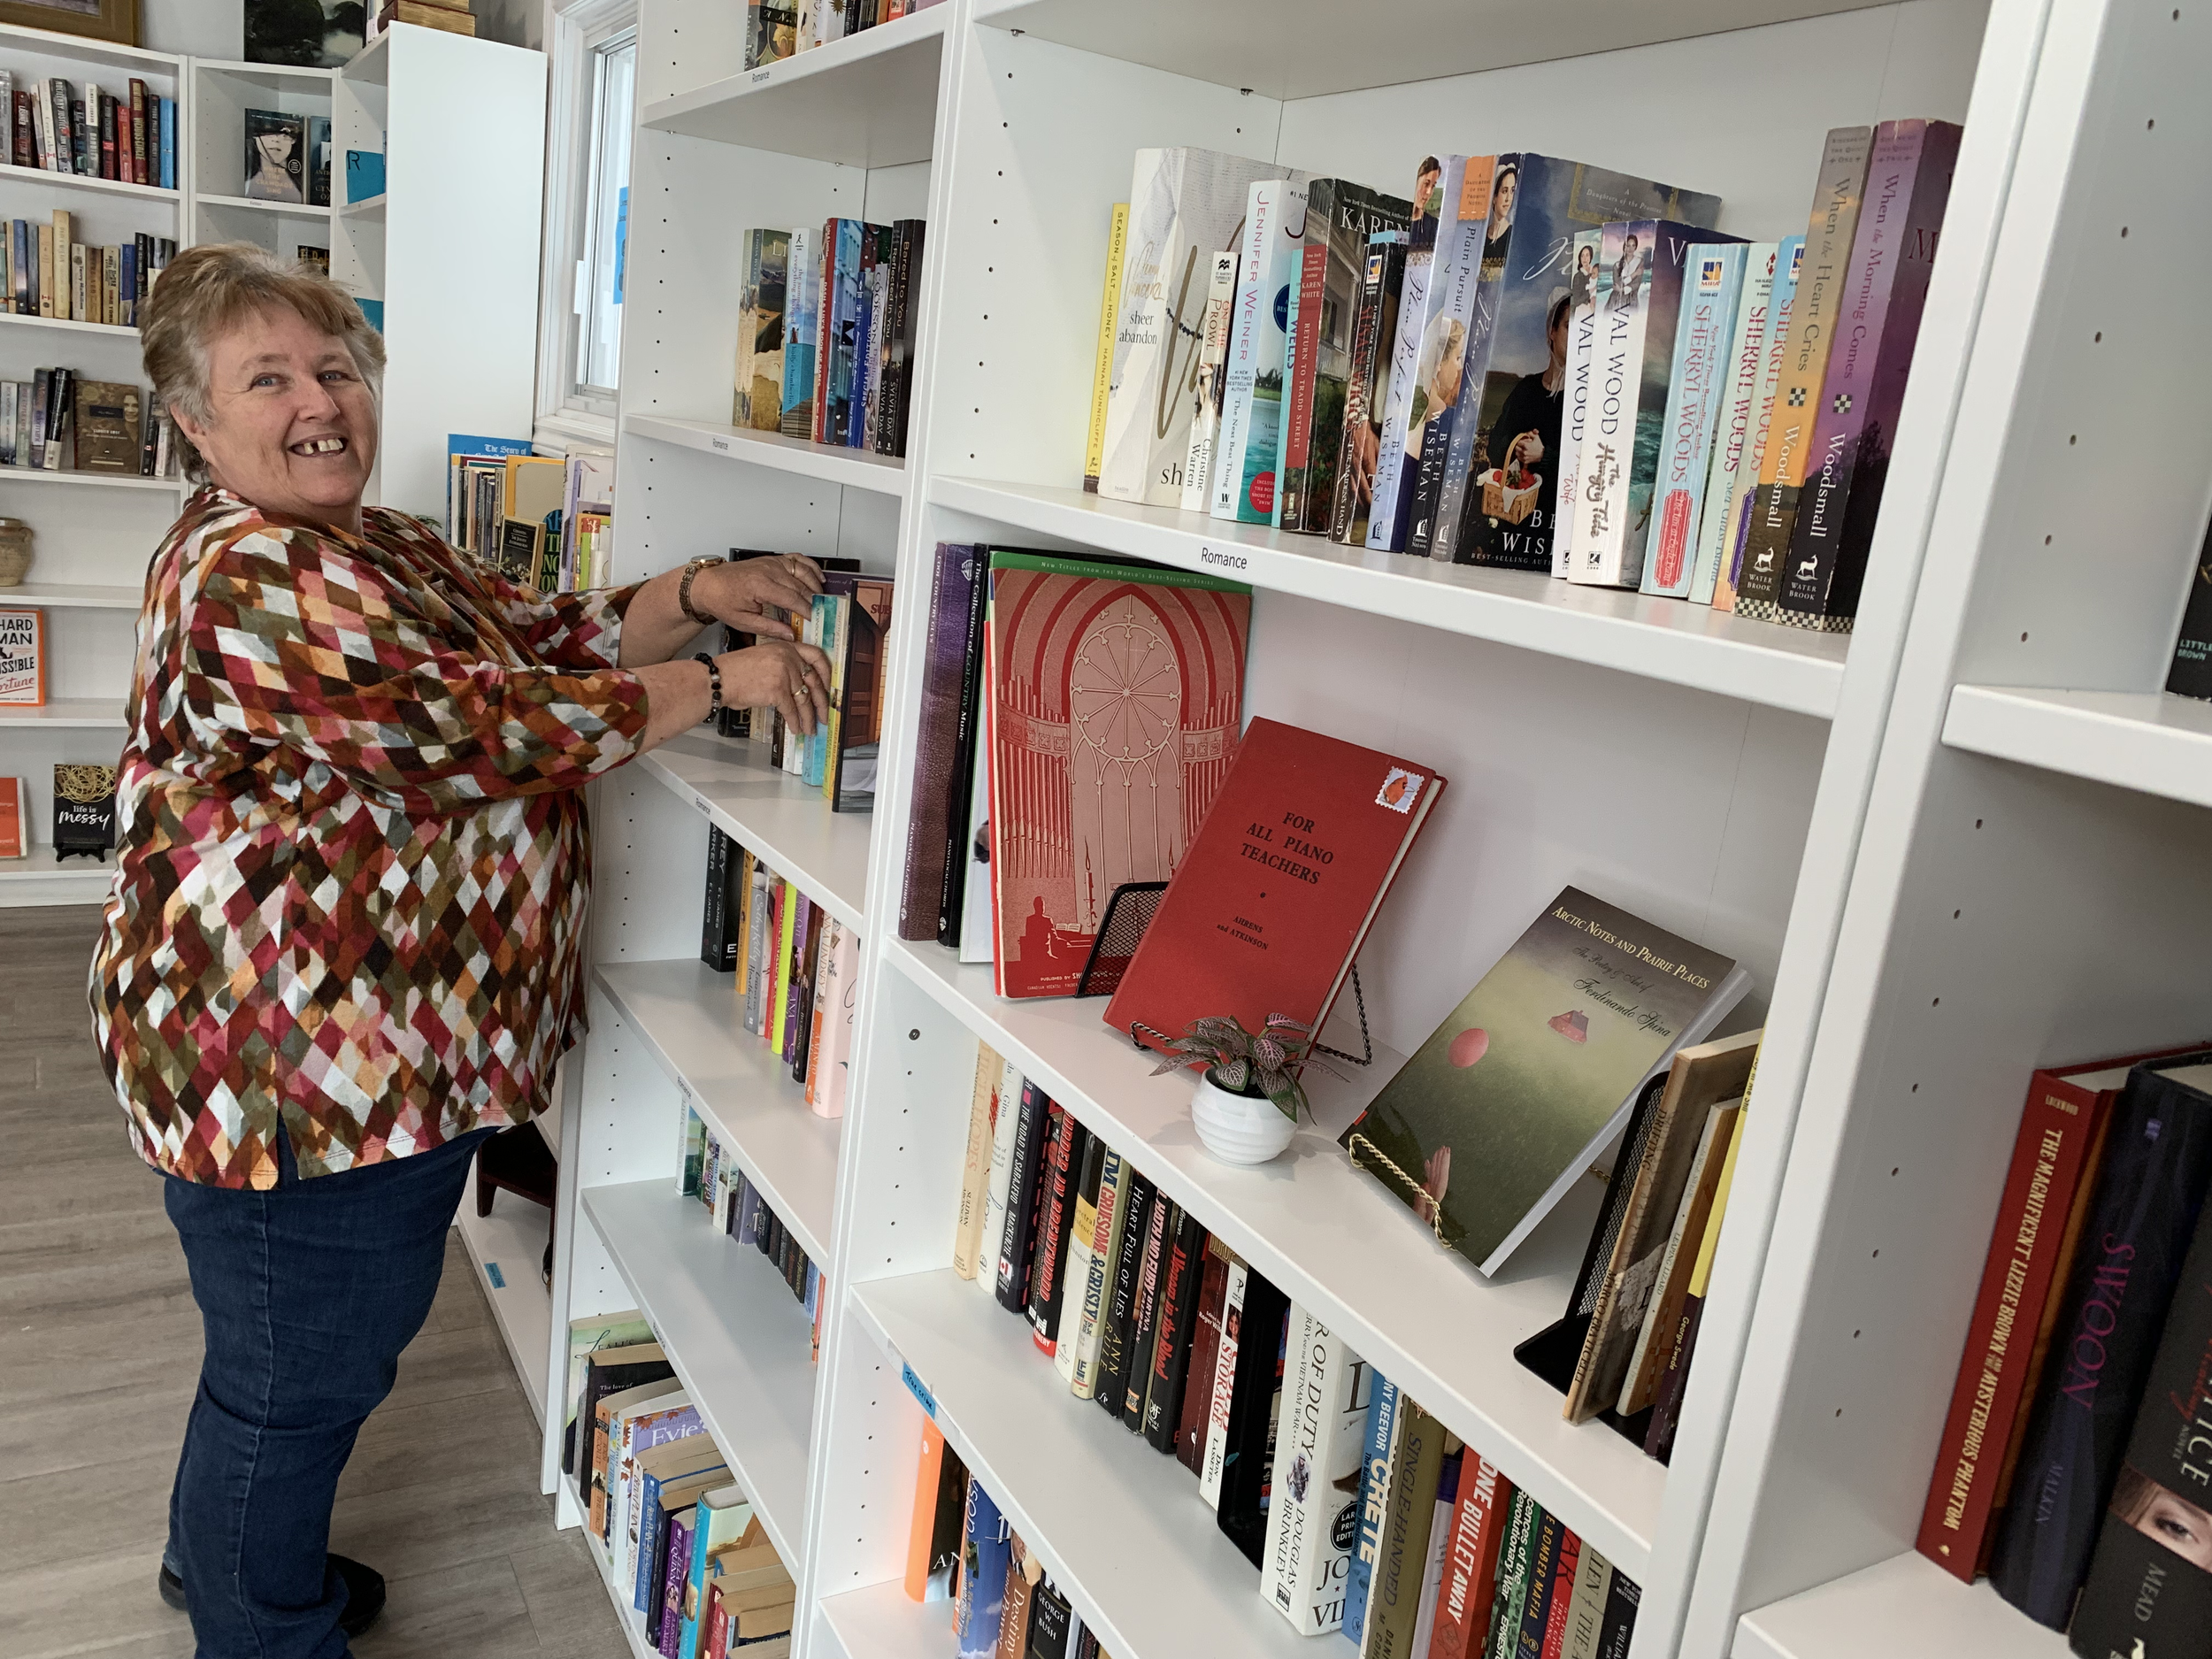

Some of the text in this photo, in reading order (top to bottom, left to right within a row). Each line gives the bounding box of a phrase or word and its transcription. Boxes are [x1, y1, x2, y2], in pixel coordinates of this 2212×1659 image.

[752, 70, 770, 84] Romance
[1825, 178, 1852, 235] When
[1876, 173, 1901, 224] When
[900, 241, 910, 281] Bared
[1820, 241, 1833, 259] the
[1870, 229, 1884, 244] the
[899, 284, 906, 298] to
[1239, 189, 1271, 361] JENNIFER WEINER
[1301, 290, 1321, 299] WHITE
[1454, 225, 1478, 313] Plain Pursuit
[1808, 265, 1832, 321] Heart
[1852, 249, 1883, 323] Morning
[871, 272, 882, 344] COOKSON
[1129, 310, 1155, 326] sheer
[1206, 297, 1223, 351] PROWL
[1118, 328, 1158, 346] abandon
[1737, 305, 1768, 394] SHERRYL
[1797, 324, 1820, 373] Cries
[1844, 325, 1868, 380] Comes
[1292, 322, 1312, 449] RETURN TO TRADD STREET
[1571, 314, 1595, 442] VAL WOOD
[1601, 302, 1632, 435] VAL WOOD
[1671, 304, 1713, 483] SHERRYL WOODS
[879, 380, 887, 412] SYLVIA
[886, 381, 896, 436] SYLVIA DAY
[712, 438, 728, 451] Romance
[1223, 396, 1241, 488] The Next Best Thing
[1374, 416, 1394, 503] WISEMAN
[1386, 440, 1401, 482] BETH
[1417, 409, 1442, 502] WISEMAN
[1432, 432, 1448, 482] BETH
[1724, 399, 1751, 473] WOODS
[1187, 442, 1202, 488] Warren
[1196, 437, 1211, 493] Christine
[1440, 436, 1462, 512] WISEMAN
[1560, 473, 1575, 506] Wife
[1766, 425, 1801, 529] Woodsmall
[1809, 432, 1847, 538] Woodsmall
[1201, 547, 1248, 570] Romance
[1471, 552, 1530, 565] BEST-SELLING
[1748, 573, 1772, 584] WATER
[1747, 581, 1770, 592] BROOK
[1788, 590, 1815, 601] BROOK
[1791, 582, 1816, 593] WATER
[958, 561, 983, 741] The Collection of COUNTRY Music
[58, 810, 111, 831] messy
[73, 804, 96, 814] life is
[1282, 811, 1316, 833] FOR
[1240, 843, 1321, 885] TEACHERS
[1245, 822, 1334, 864] ALL PIANO
[749, 894, 764, 962] Cathy Kelly
[1217, 923, 1269, 950] and ATKINSON
[1233, 916, 1263, 933] AHRENS
[1551, 905, 1710, 989] ARCTIC NOTES AND PRAIRIE PLACES
[816, 945, 830, 989] LINDSEY
[1573, 978, 1672, 1039] Ferdinando Spina
[1640, 1109, 1668, 1171] DRIFTING
[1002, 1104, 1031, 1258] THE ROAD TO SARAJEVO MACKENZIE
[1039, 1110, 1075, 1302] URDER IN BRENTWOOD
[1092, 1186, 1116, 1256] GRUESOME
[1128, 1186, 1144, 1232] HEART
[1090, 1253, 1106, 1268] &
[1123, 1233, 1137, 1267] FULL
[1989, 1128, 2064, 1356] THE MAGNIFICENT LIZZIE BROWN
[1082, 1265, 1103, 1321] GRISLY
[1115, 1288, 1129, 1319] LIES
[1119, 1269, 1130, 1290] OF
[1142, 1294, 1154, 1332] BRYNA
[2062, 1232, 2136, 1410] SWOON
[1100, 1321, 1114, 1372] RULE
[1109, 1333, 1123, 1377] ANN
[1669, 1316, 1690, 1371] George Swede
[1211, 1340, 1233, 1429] STORAGE
[1302, 1344, 1327, 1462] OF DUTY
[1375, 1402, 1394, 1452] BEEVOR
[1943, 1368, 1999, 1532] MYSTERIOUS PHANTOM
[1207, 1437, 1219, 1484] LASSETER
[1362, 1466, 1371, 1490] Battle
[1358, 1457, 1388, 1564] CRETE
[1384, 1432, 1423, 1608] SINGLE-HANDED
[1275, 1497, 1294, 1580] BRINKLEY
[1286, 1506, 1306, 1588] DOUGLAS
[1352, 1517, 1363, 1557] Resistance
[1447, 1456, 1499, 1626] ONE BULLET AWAY
[1501, 1489, 1526, 1601] Revolutionary War
[669, 1546, 680, 1584] QUINN
[1514, 1546, 1528, 1586] of the
[1528, 1525, 1555, 1620] BOMBER MAFIA
[1037, 1593, 1065, 1624] GEORGE
[2133, 1562, 2168, 1622] MEAD
[1005, 1587, 1025, 1659] Destiny
[1038, 1617, 1057, 1641] BUSH
[1043, 1611, 1053, 1625] W.
[1574, 1611, 1594, 1653] THE
